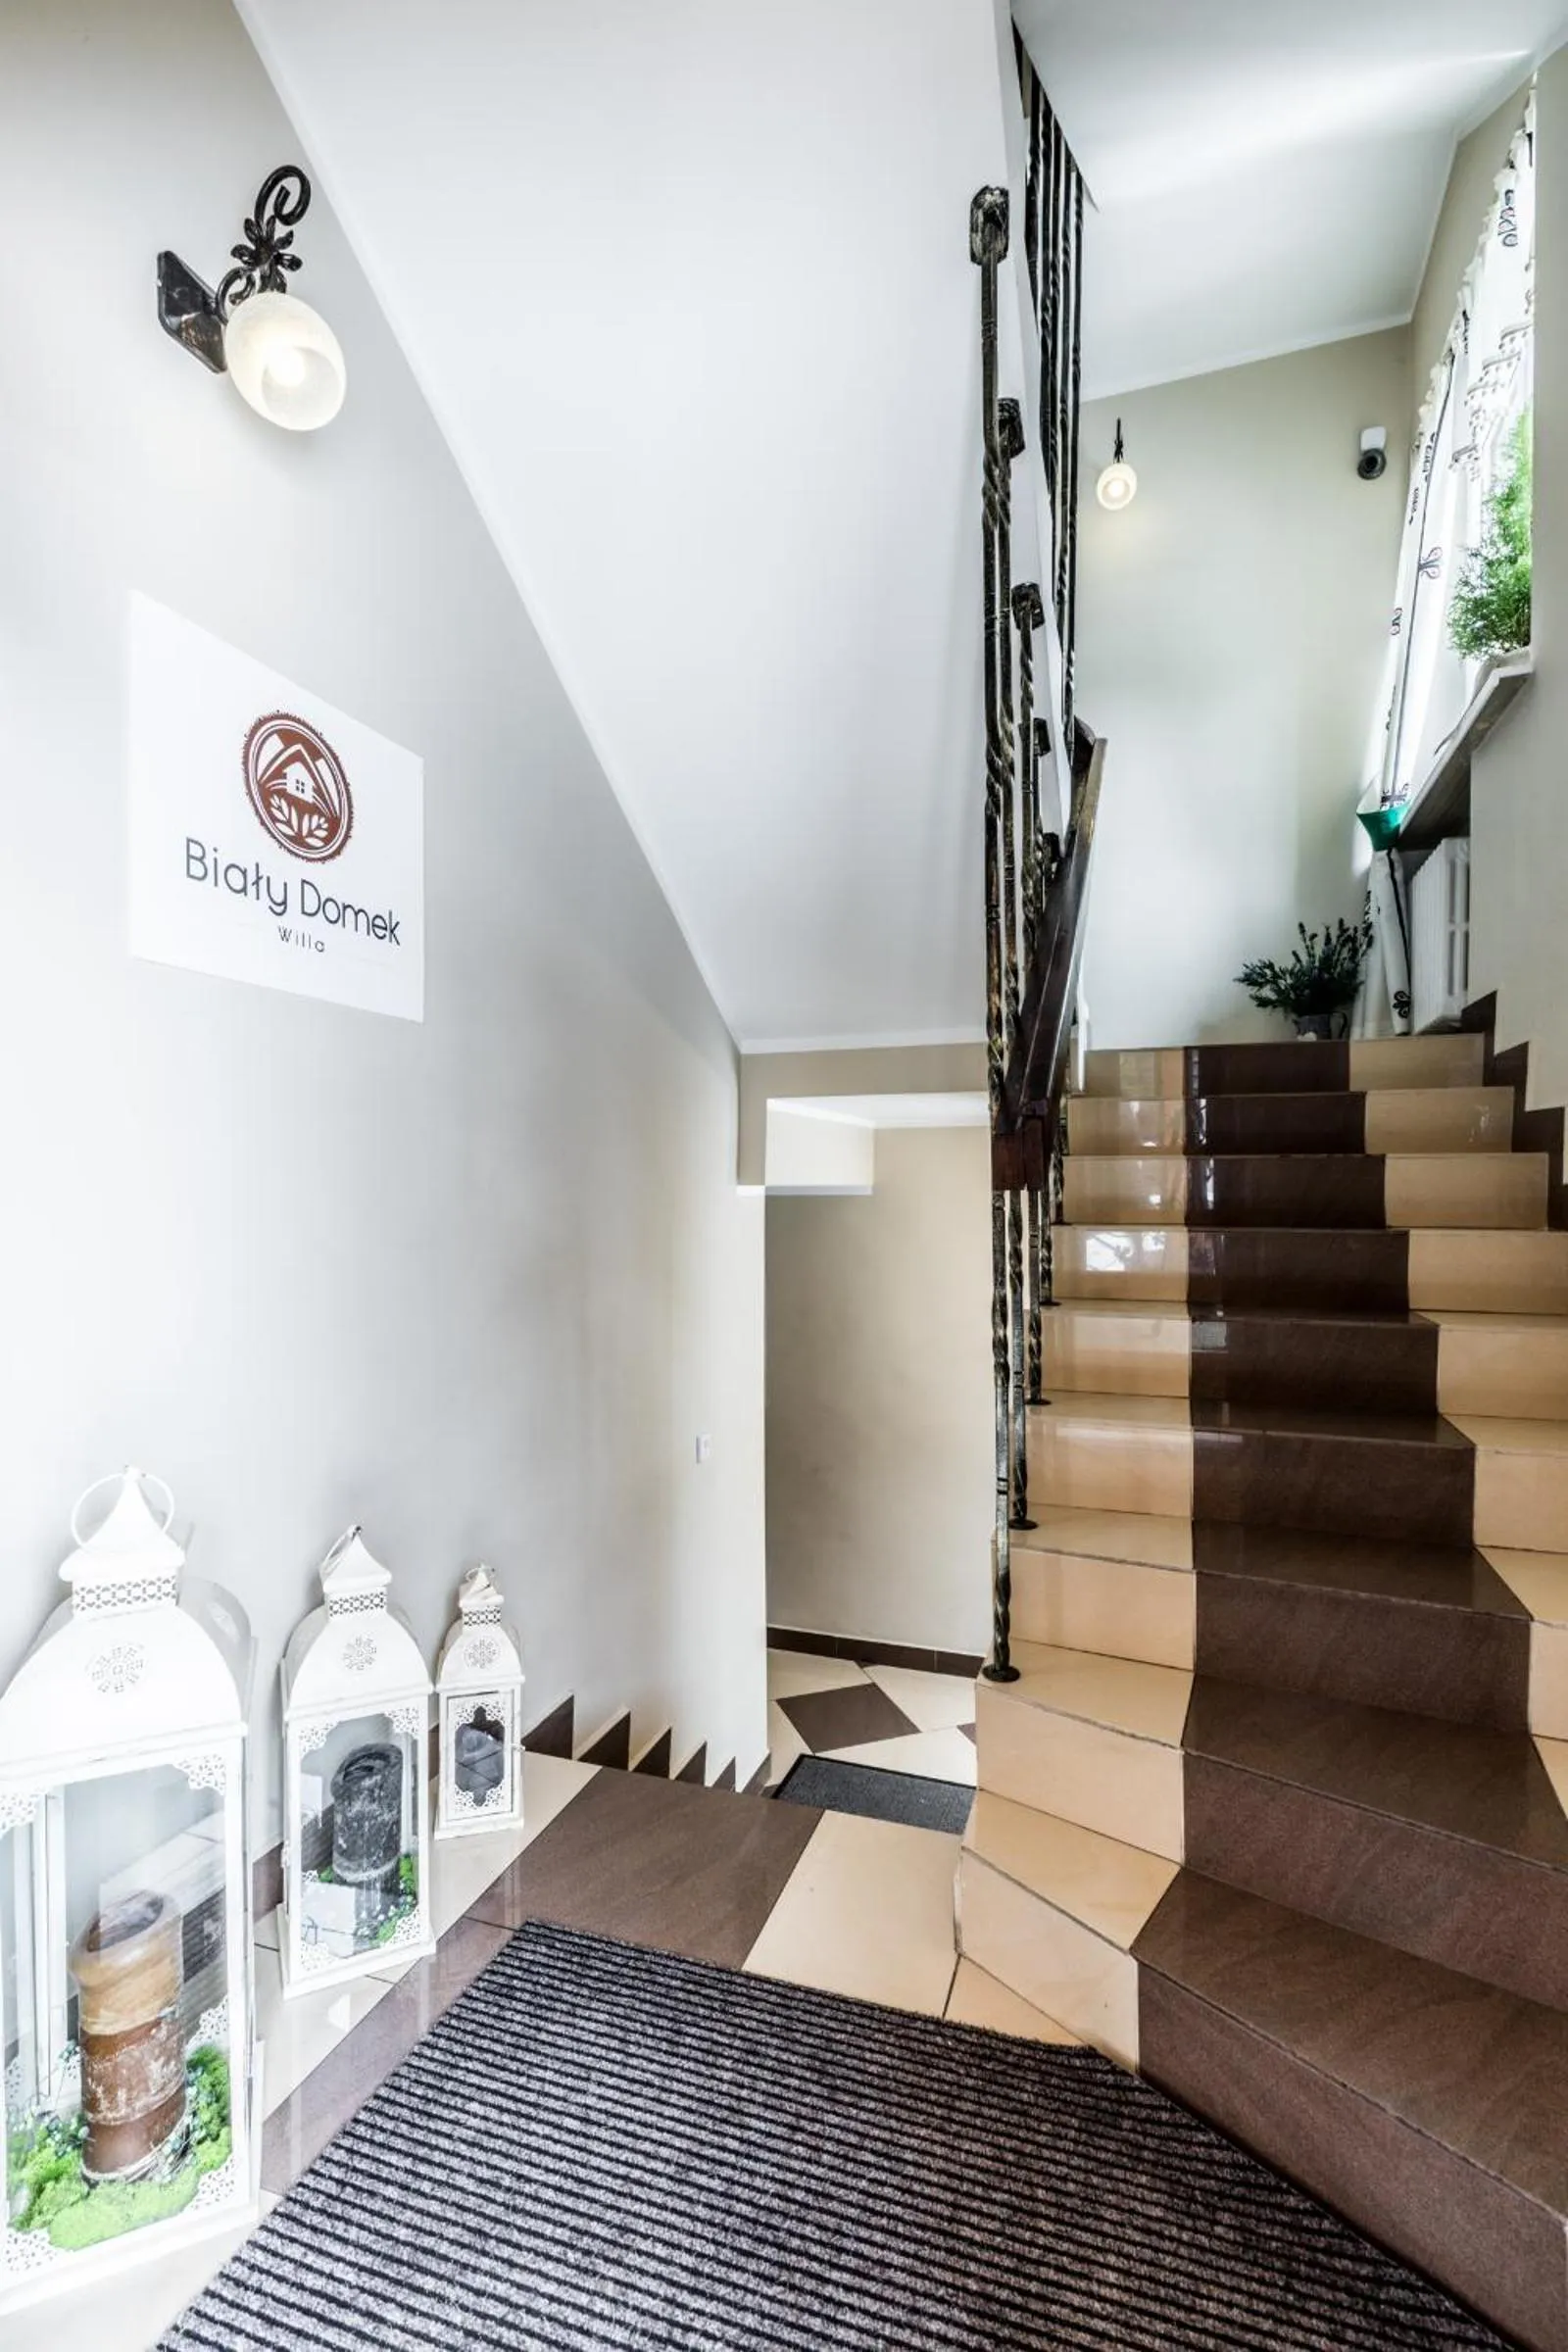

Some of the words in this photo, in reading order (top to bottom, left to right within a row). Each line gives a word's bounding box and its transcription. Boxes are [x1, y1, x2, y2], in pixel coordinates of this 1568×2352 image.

[185, 836, 288, 917] Biały
[300, 878, 401, 947] Domek
[278, 926, 325, 954] Willa
